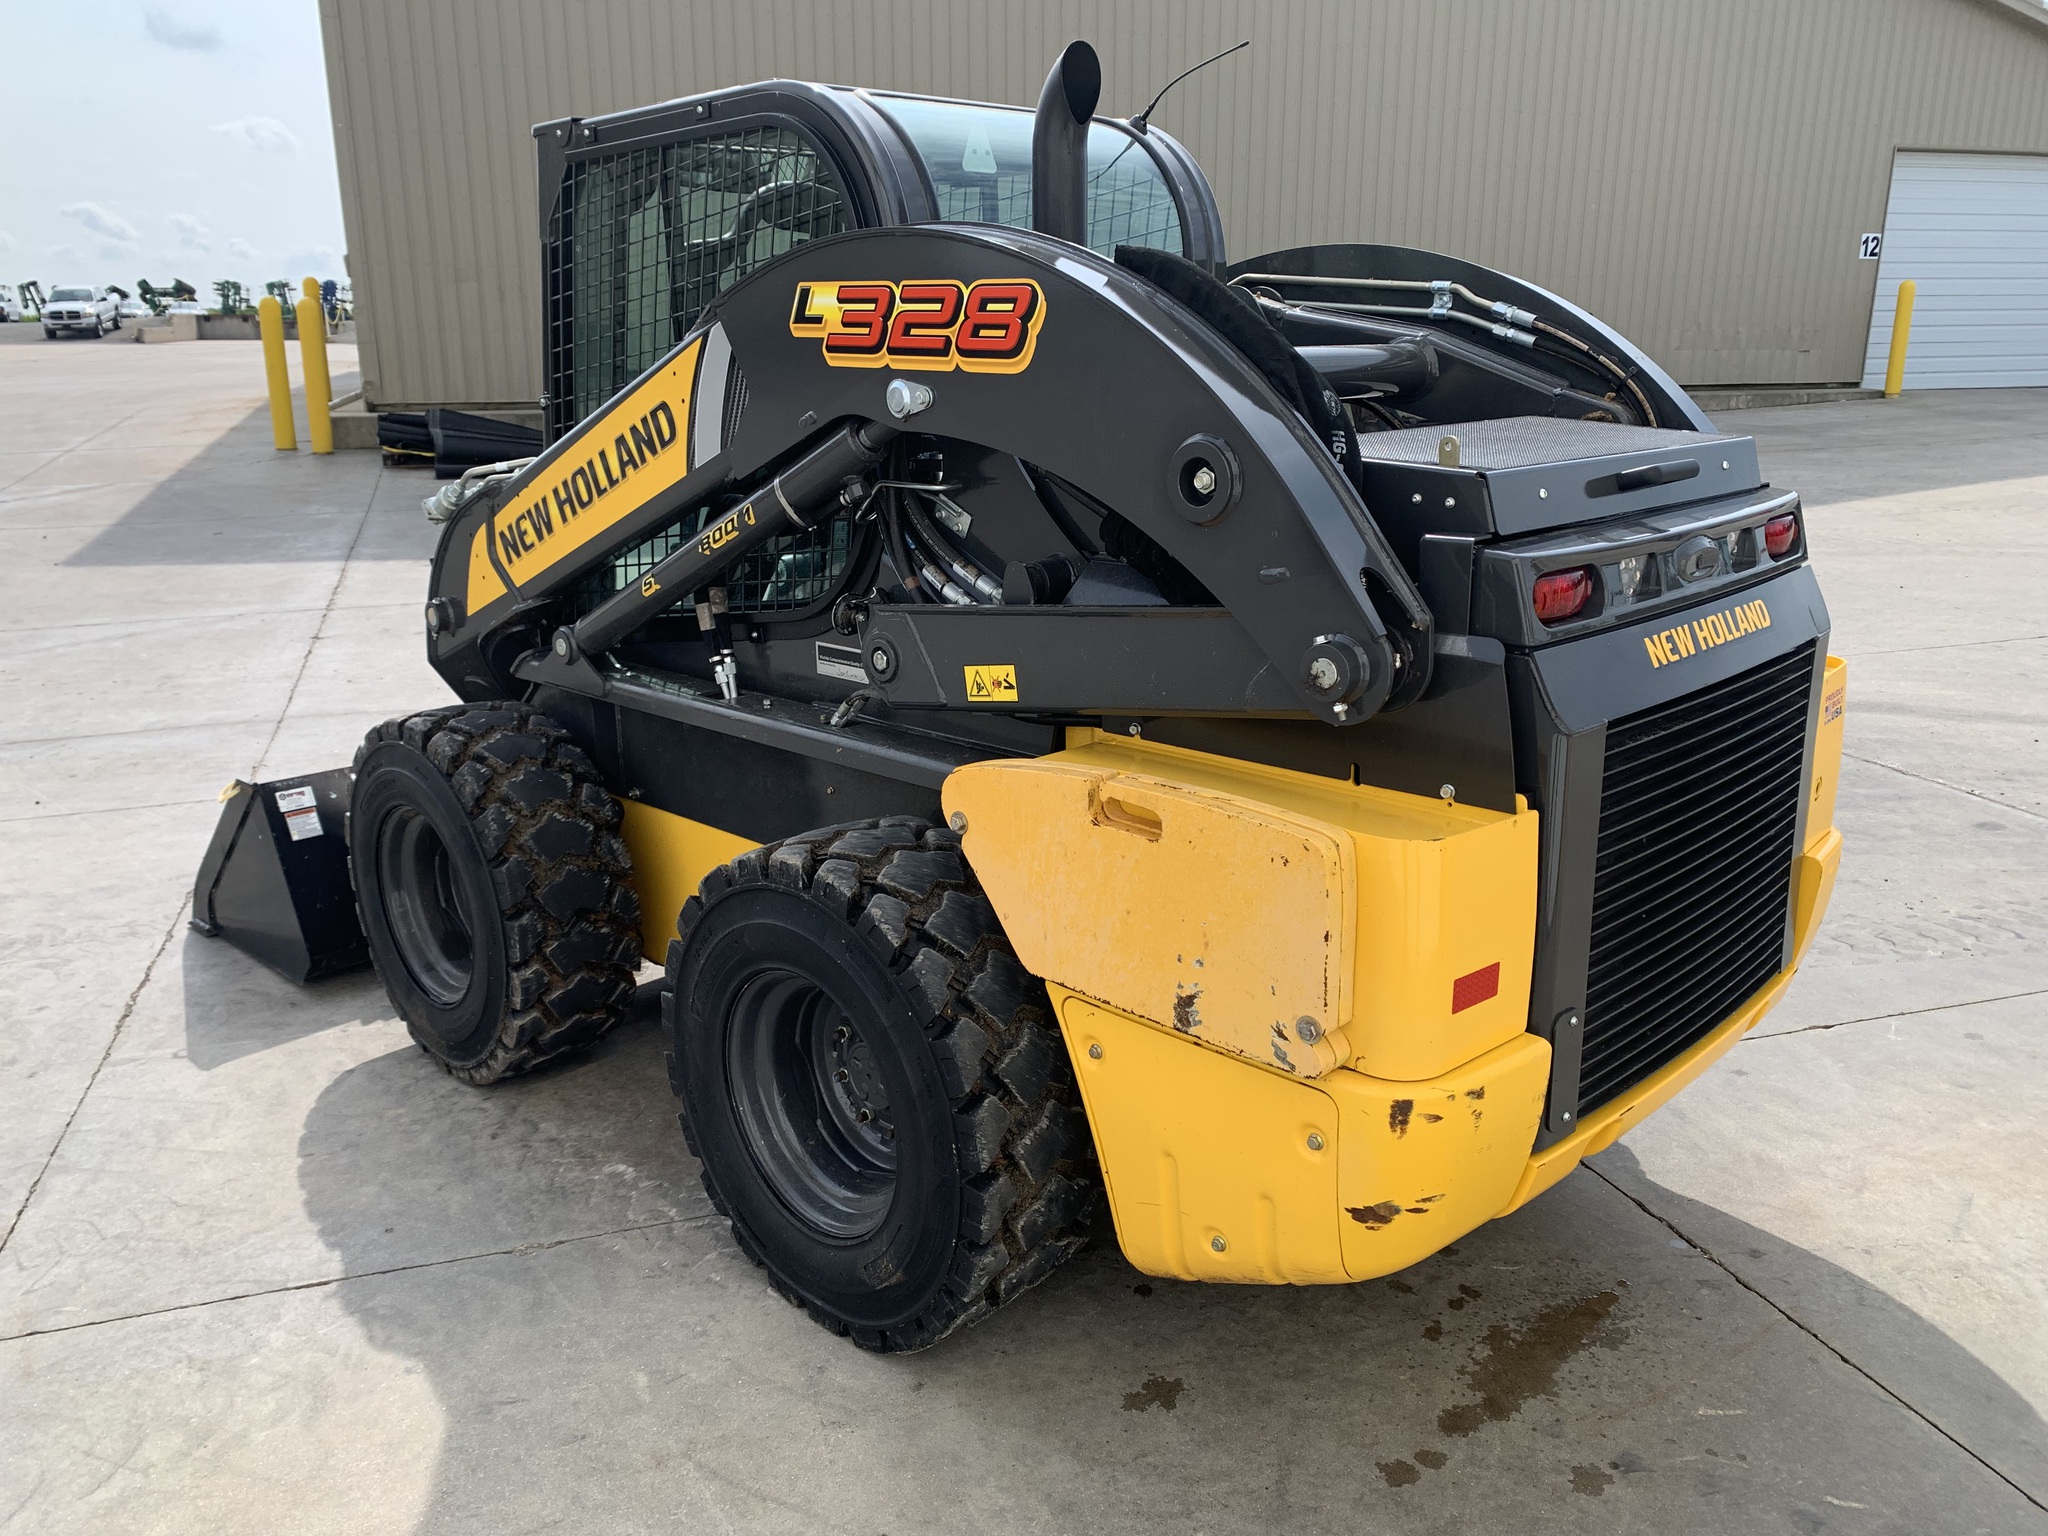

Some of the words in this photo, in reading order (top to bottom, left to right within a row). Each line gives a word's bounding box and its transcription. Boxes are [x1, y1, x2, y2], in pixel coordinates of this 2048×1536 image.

[1861, 235, 1880, 257] 12
[790, 282, 1042, 364] L328
[498, 496, 555, 569] NEW
[551, 400, 678, 527] HOLLAND
[1643, 623, 1697, 669] NEW
[1692, 599, 1771, 651] HOLLAND
